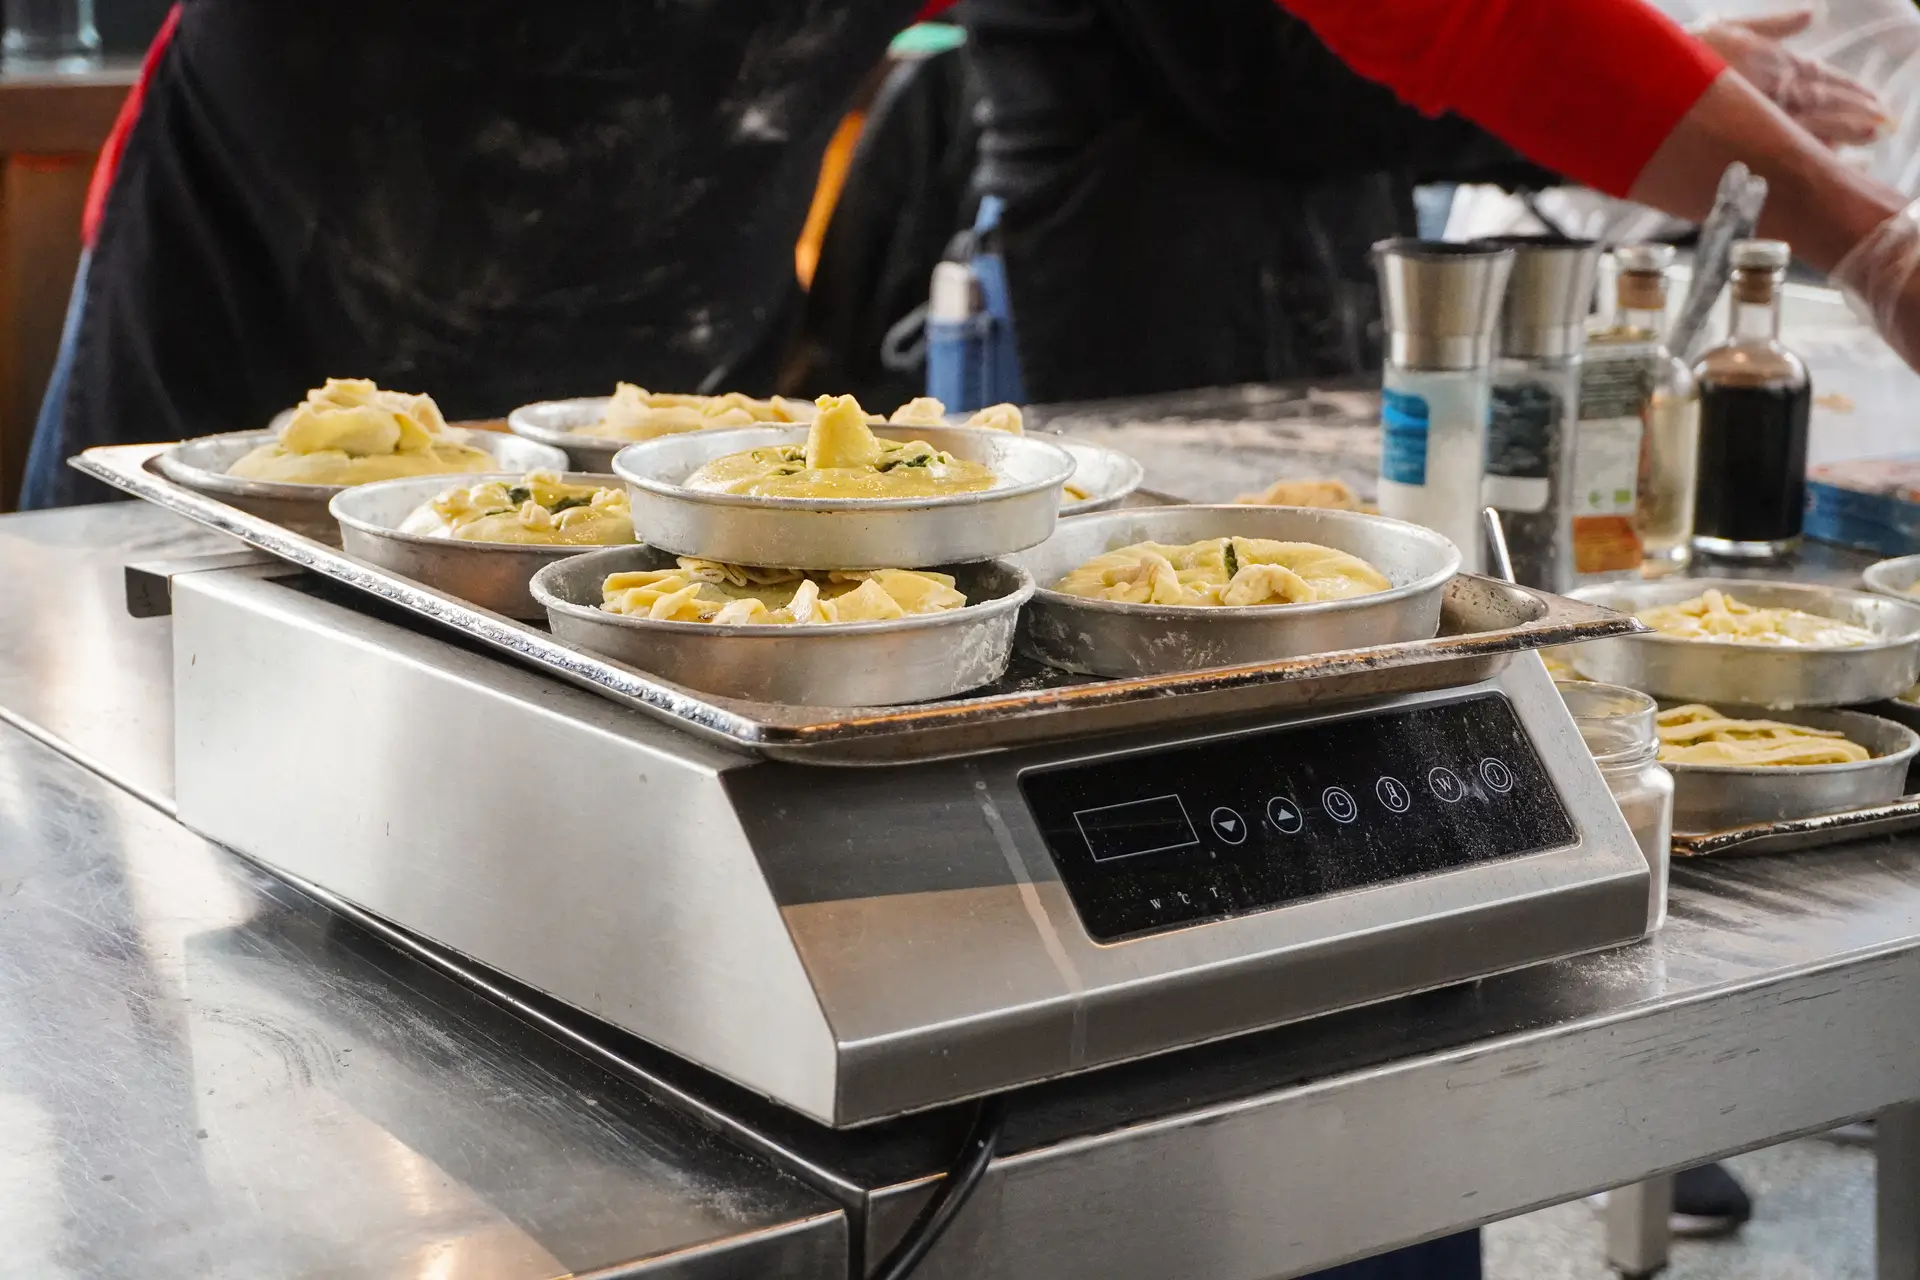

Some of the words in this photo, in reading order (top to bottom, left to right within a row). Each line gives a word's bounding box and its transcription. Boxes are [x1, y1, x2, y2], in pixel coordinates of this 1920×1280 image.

[1435, 776, 1452, 792] W
[1149, 898, 1161, 909] W
[1209, 887, 1218, 898] T
